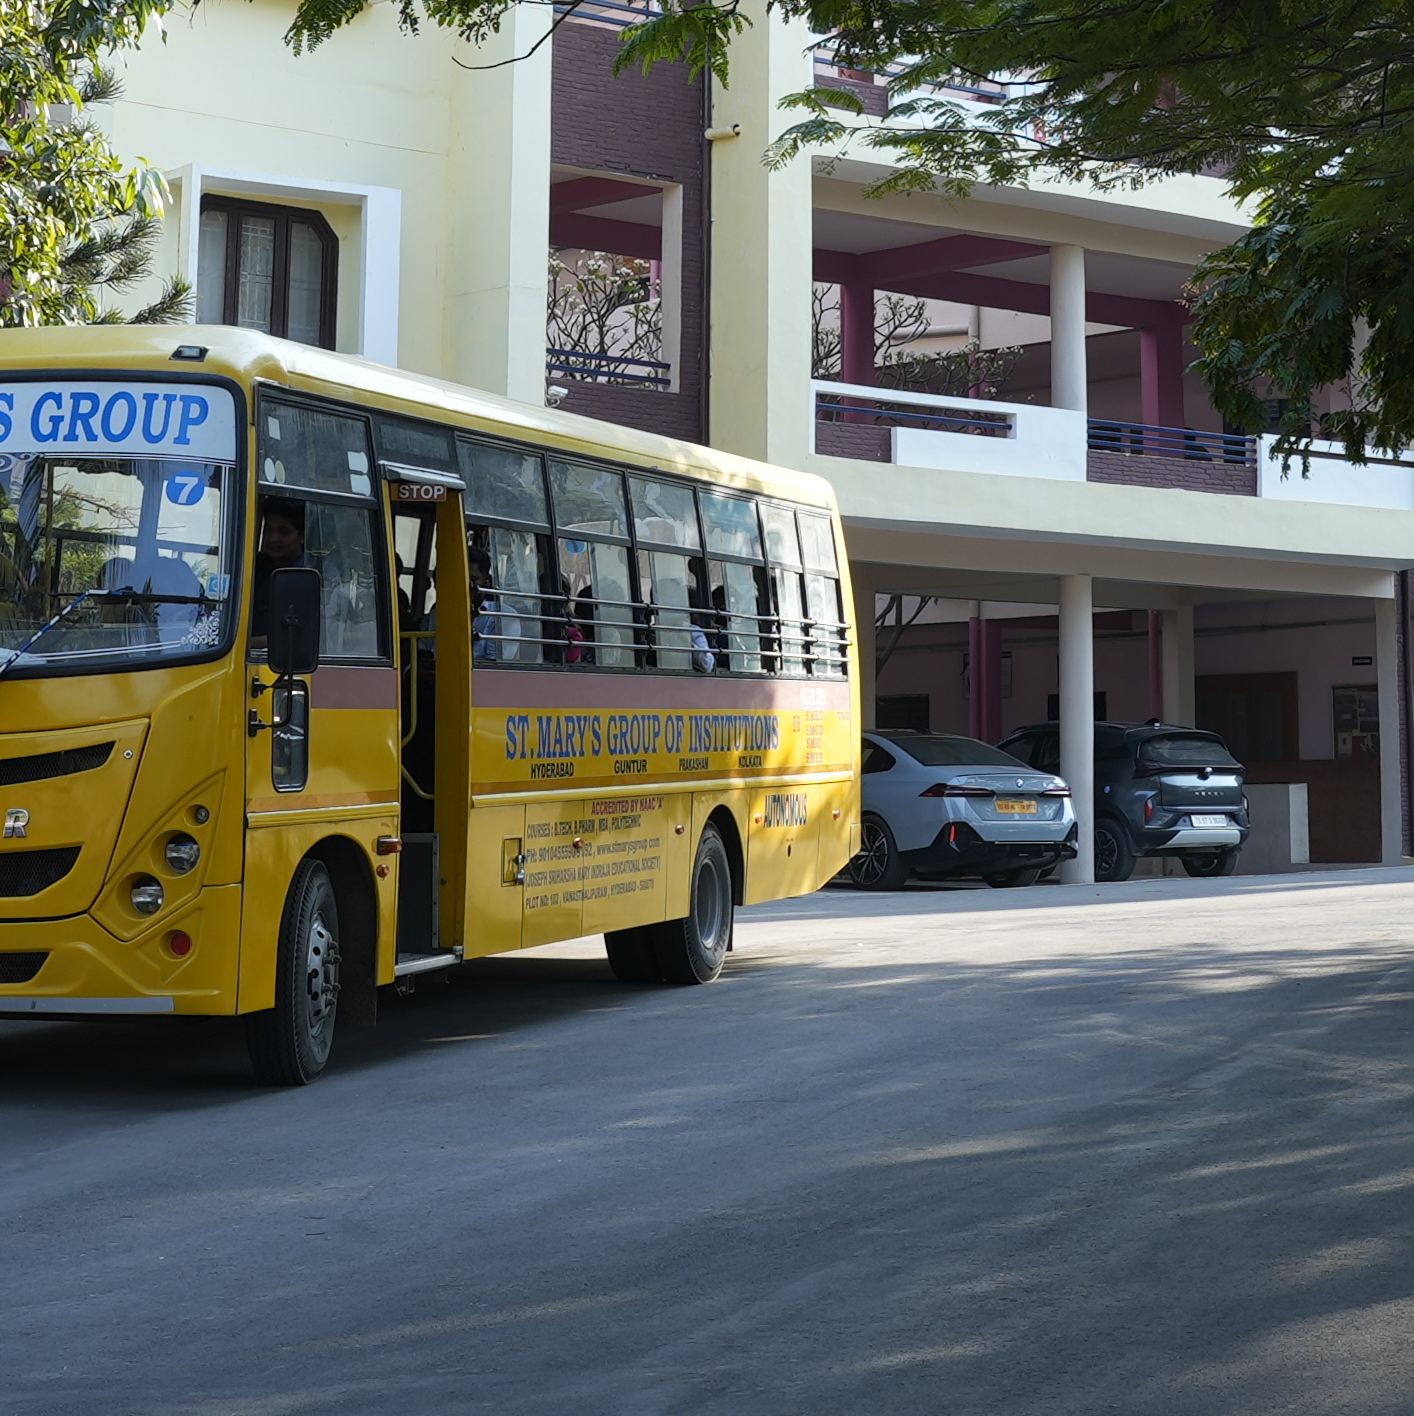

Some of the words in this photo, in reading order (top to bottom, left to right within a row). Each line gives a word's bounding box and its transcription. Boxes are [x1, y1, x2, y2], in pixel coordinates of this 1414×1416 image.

[30, 391, 209, 446] GROUP
[174, 476, 199, 504] 7
[398, 484, 445, 500] STOP
[606, 714, 661, 756] GROUP
[664, 714, 685, 754] OF
[688, 714, 780, 753] INSTITUTIONS
[530, 761, 575, 779] HYDERABAD
[614, 759, 648, 774] GUNTUR
[738, 755, 763, 769] KOLKATA
[591, 798, 629, 815] ACCREDITED
[630, 798, 639, 813] BY
[763, 792, 807, 829] AUTONOMOUS
